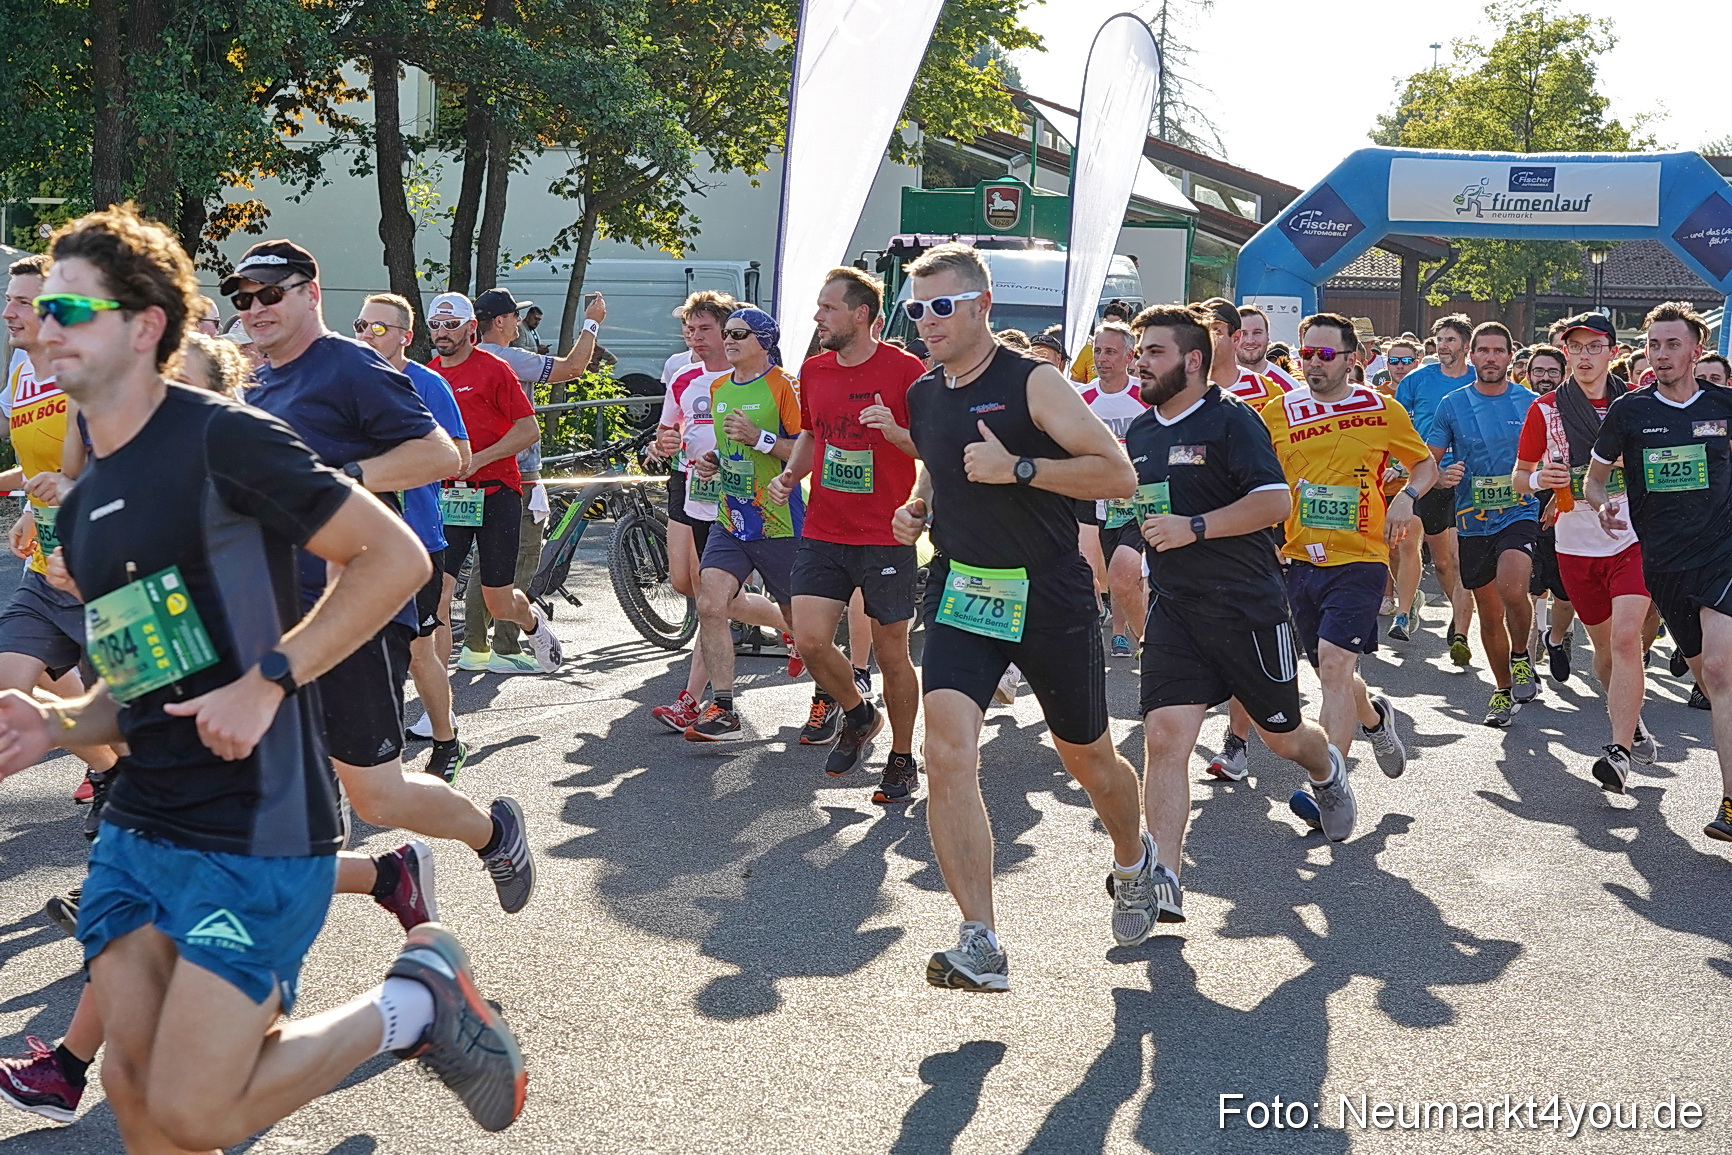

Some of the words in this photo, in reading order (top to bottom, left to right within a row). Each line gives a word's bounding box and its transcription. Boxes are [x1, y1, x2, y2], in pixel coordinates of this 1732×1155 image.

[1492, 193, 1593, 211] firmenlauf
[1299, 218, 1352, 232] Fischer
[1303, 229, 1347, 237] AUTOMOBILE
[1690, 230, 1704, 239] und
[1706, 228, 1720, 236] das
[996, 284, 1060, 293] DATASPORT
[11, 410, 34, 430] MAX
[36, 399, 67, 421] BÖG
[1289, 424, 1332, 444] MAX
[1337, 415, 1387, 430] BÖGL
[829, 461, 863, 479] 1660
[1660, 461, 1692, 477] 425
[841, 477, 860, 486] Fabian
[1616, 469, 1625, 488] 2022
[1479, 486, 1512, 500] 1914
[445, 501, 476, 514] 1705
[1309, 499, 1349, 516] 1633
[943, 597, 955, 614] RUN
[964, 593, 1004, 618] 778
[953, 611, 984, 623] Schlierf
[984, 618, 1009, 628] Bernd
[1010, 604, 1023, 633] 2022
[142, 622, 170, 669] 2022
